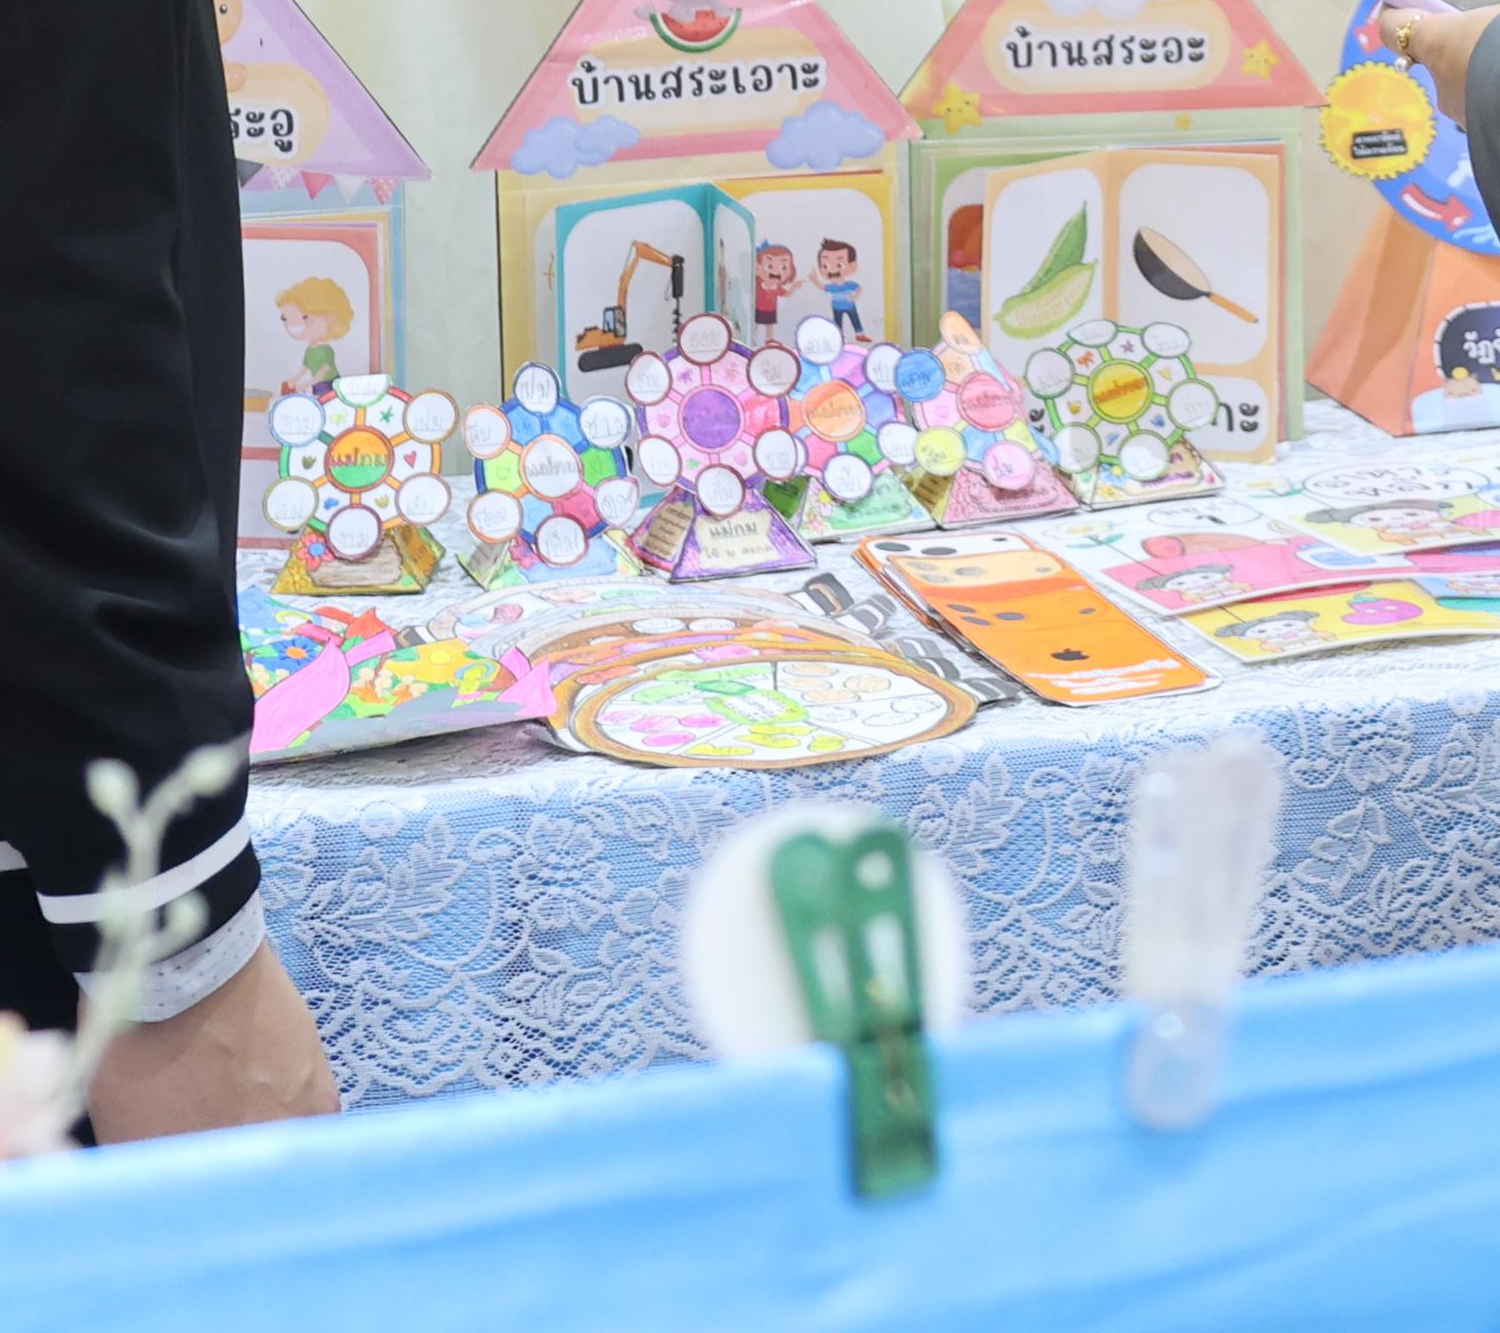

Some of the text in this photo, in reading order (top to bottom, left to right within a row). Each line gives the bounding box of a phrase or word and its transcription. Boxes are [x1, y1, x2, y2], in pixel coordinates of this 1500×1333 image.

[1006, 25, 1206, 69] บ้านสระอะ
[571, 60, 820, 105] บ้านสระเอาะ
